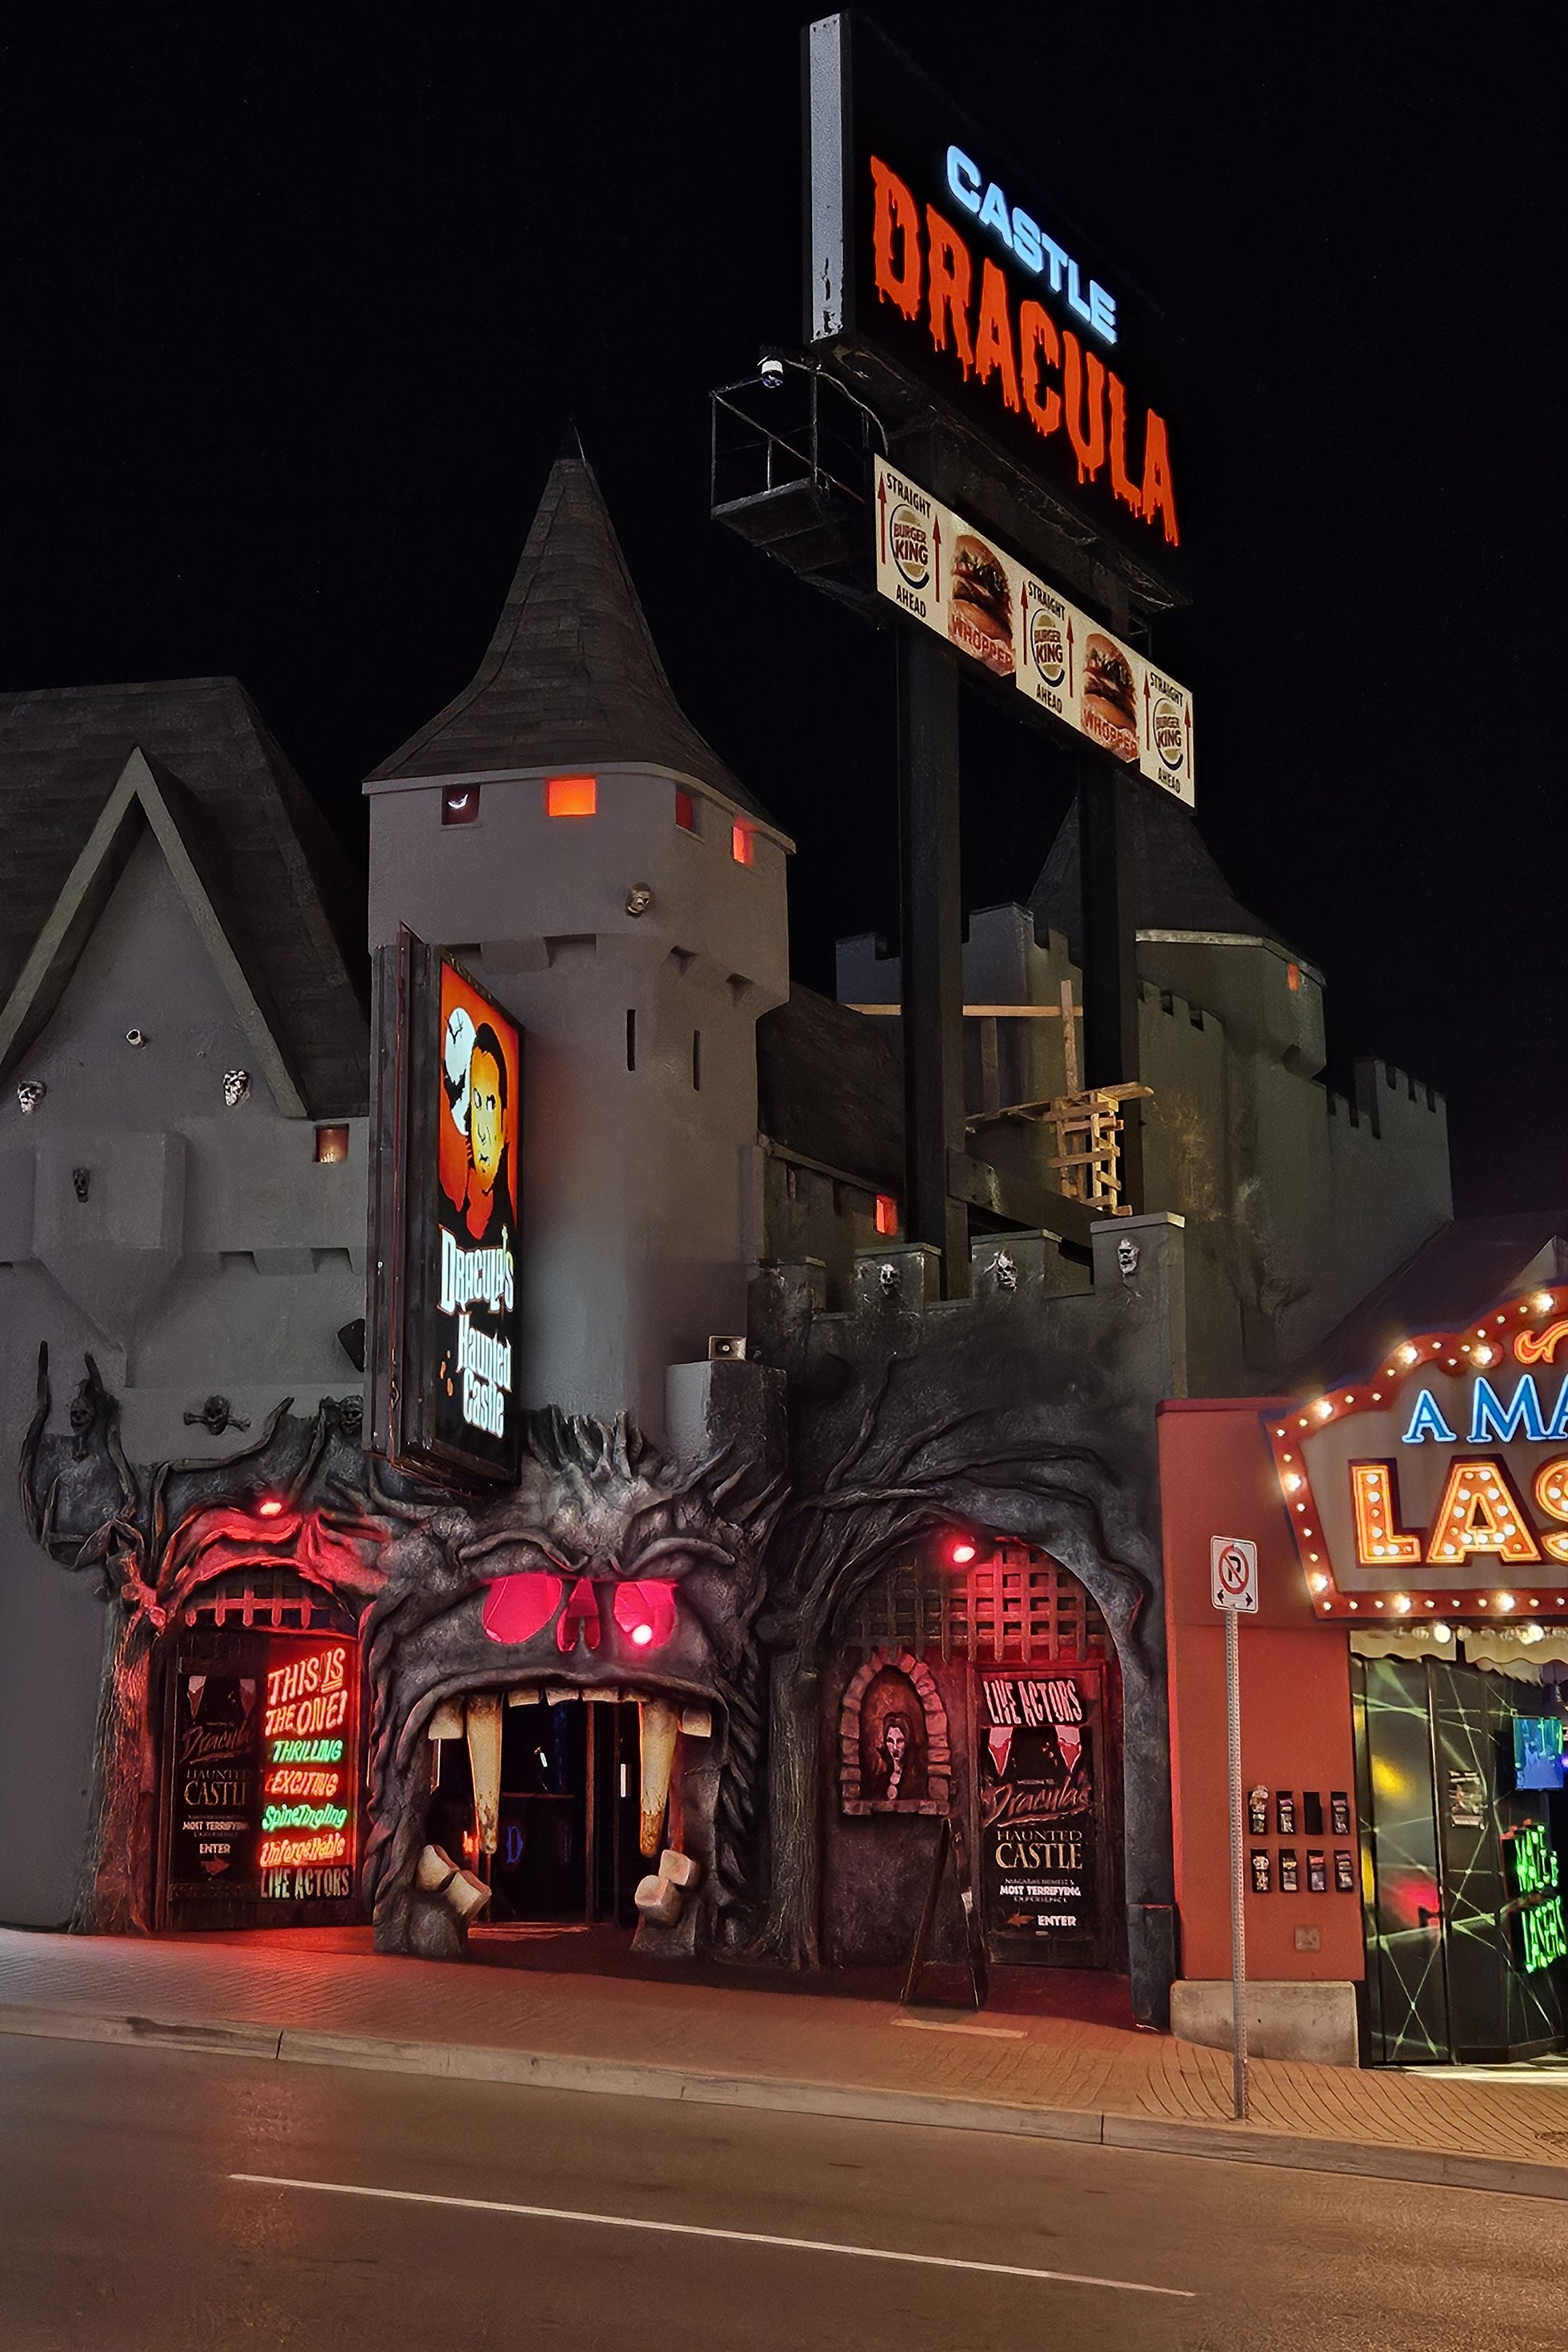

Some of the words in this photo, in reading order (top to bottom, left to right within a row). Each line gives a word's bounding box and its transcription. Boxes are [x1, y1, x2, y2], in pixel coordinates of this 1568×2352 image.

[946, 145, 1118, 344] CASTLE
[870, 155, 1180, 546] DRACULA
[886, 473, 931, 518] STRAIGHT
[894, 522, 926, 545] BURGER
[894, 542, 928, 566] KING
[896, 584, 926, 618] AHEAD
[1027, 581, 1066, 621] STRAIGHT
[1035, 642, 1063, 663] KING
[1036, 683, 1062, 714] AHEAD
[1156, 728, 1182, 748] KING
[1158, 767, 1181, 794] AHEAD
[463, 1367, 505, 1439] Castle
[268, 1657, 320, 1706] THIS
[322, 1647, 346, 1684] IS
[265, 1703, 297, 1736] THE
[297, 1690, 348, 1736] ONE!
[983, 1681, 1022, 1725] LIVE
[1018, 1681, 1083, 1726] ACTORS
[273, 1739, 343, 1762] THRILLING
[270, 1770, 338, 1797] EXCITING
[199, 1842, 231, 1854] ENTER
[260, 1832, 346, 1867] Unforgettable
[997, 1830, 1082, 1841] HAUNTED
[995, 1842, 1083, 1870] CASTLE
[261, 1868, 290, 1898] LIVE
[294, 1867, 350, 1899] ACTORS
[999, 1885, 1025, 1896] MOST
[1026, 1886, 1082, 1898] TERRIFYING
[1037, 1914, 1078, 1927] ENTER
